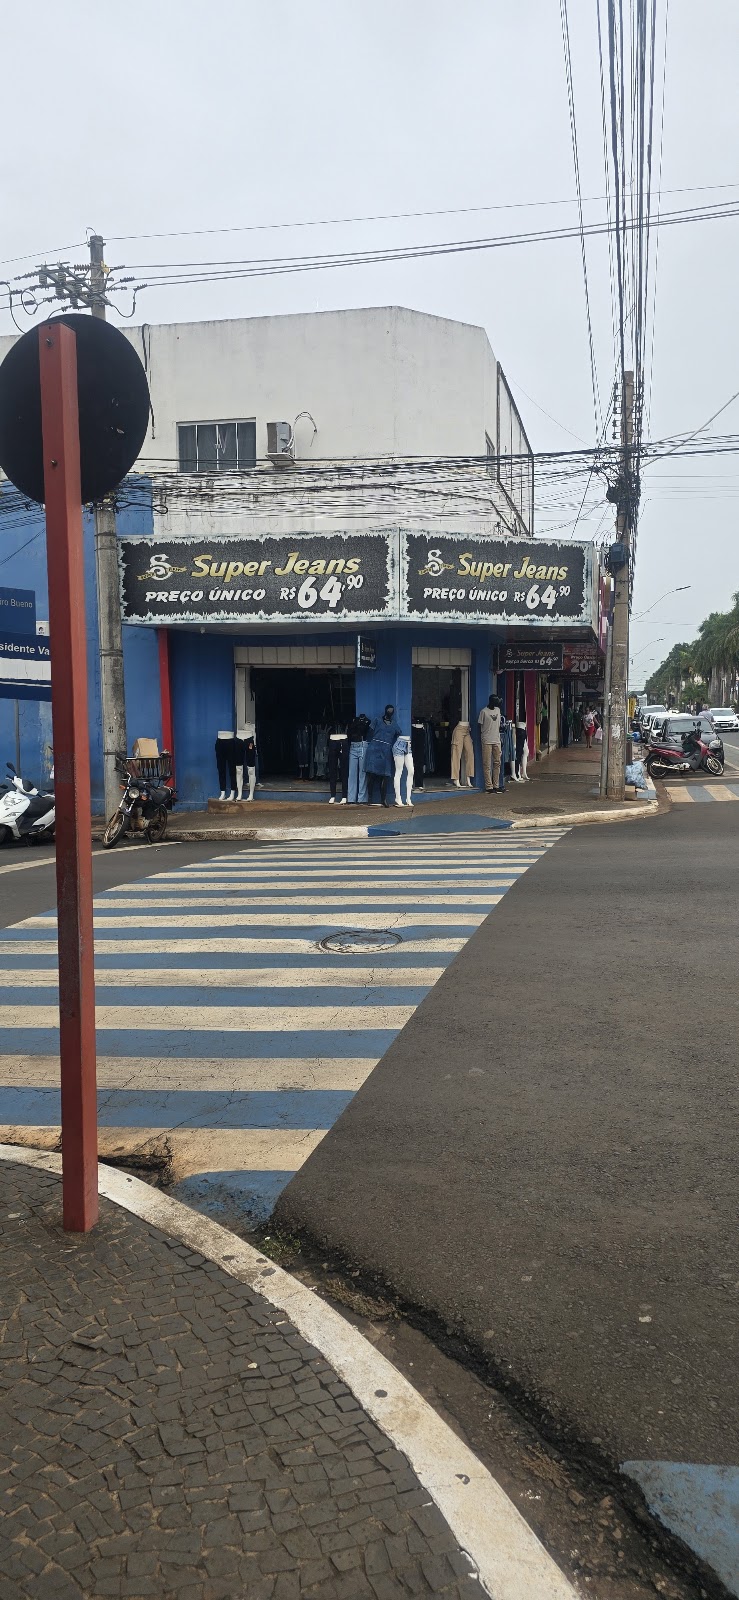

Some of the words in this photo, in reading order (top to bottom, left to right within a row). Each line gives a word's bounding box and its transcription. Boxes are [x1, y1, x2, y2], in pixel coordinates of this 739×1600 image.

[191, 554, 271, 582] Super
[275, 552, 361, 576] Jeans
[457, 552, 512, 582] Super
[513, 556, 568, 580] Jeans
[10, 598, 32, 608] Bueno
[145, 591, 203, 604] PREÇO
[209, 587, 266, 601] ÚNICO
[280, 586, 296, 600] R$
[423, 586, 466, 602] PREÇO
[469, 586, 508, 602] ÚNICO
[513, 591, 526, 603] R$
[517, 650, 535, 658] Super
